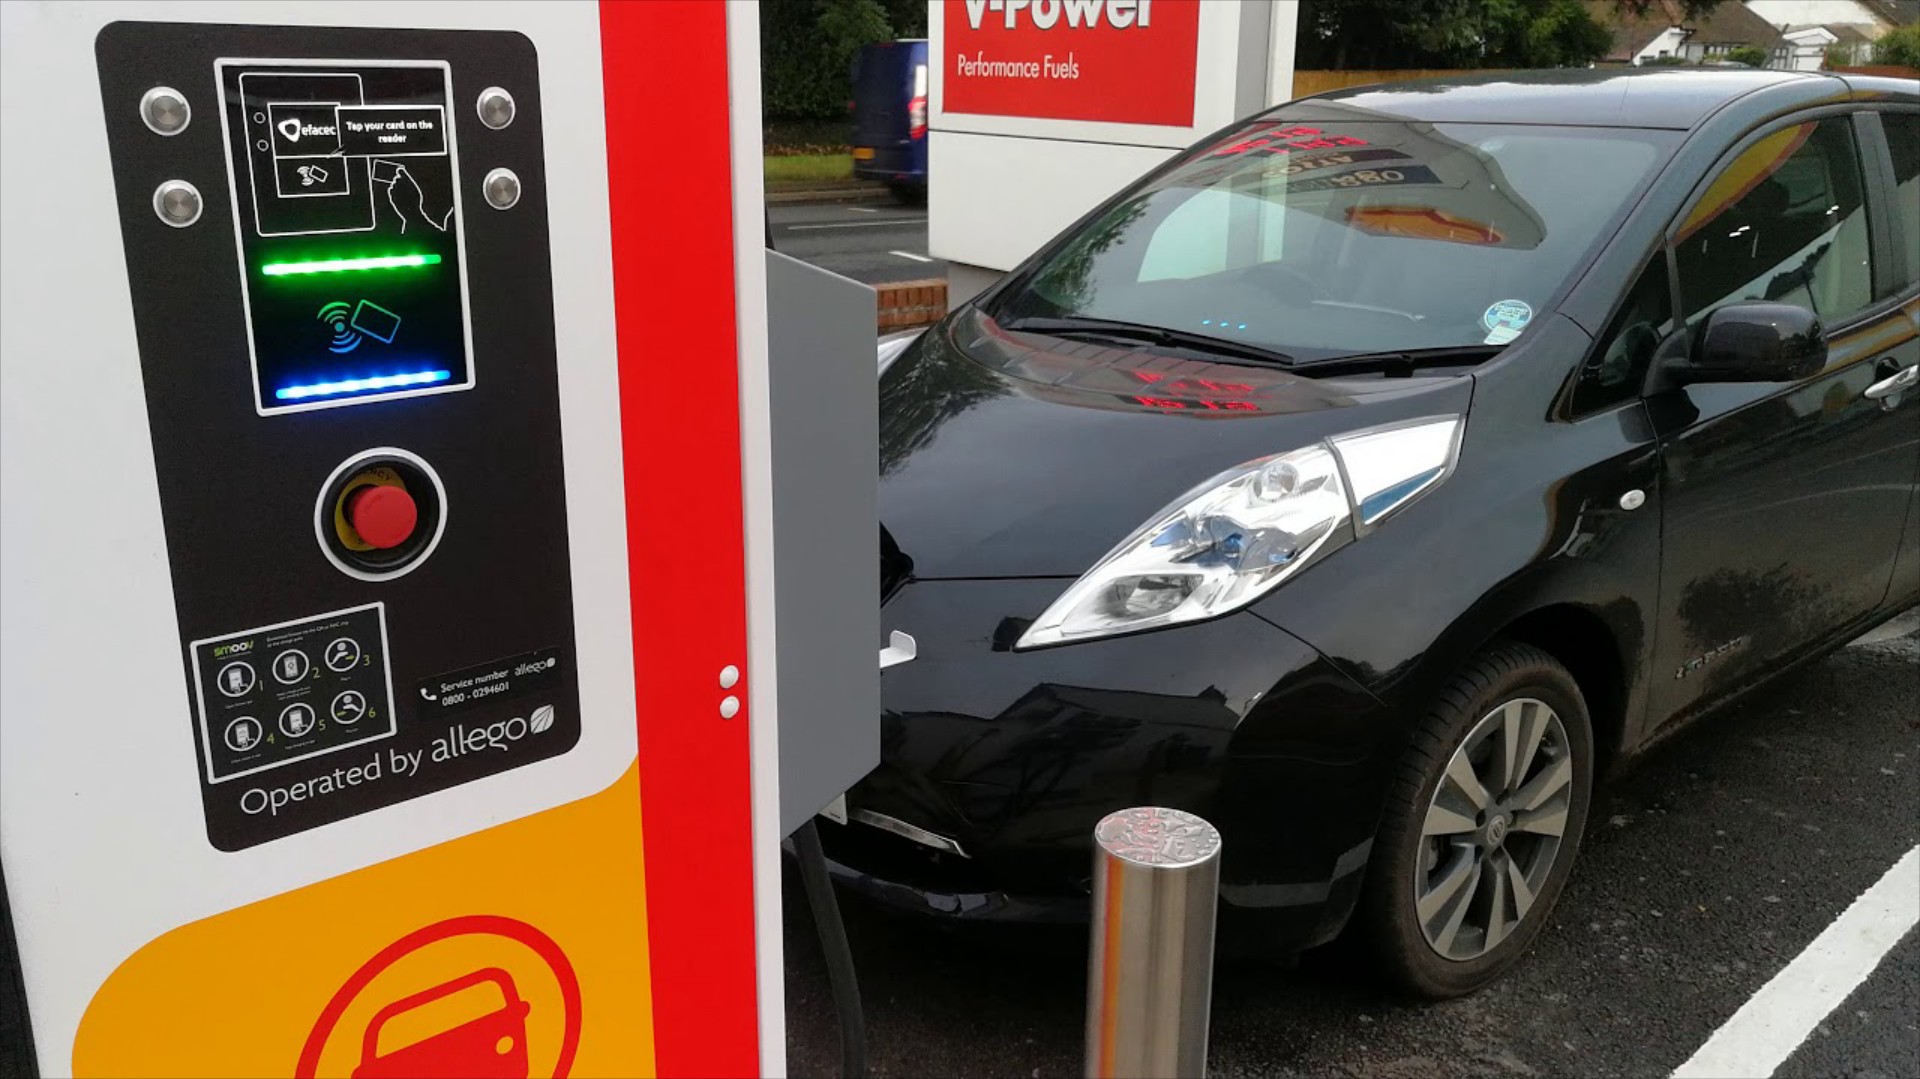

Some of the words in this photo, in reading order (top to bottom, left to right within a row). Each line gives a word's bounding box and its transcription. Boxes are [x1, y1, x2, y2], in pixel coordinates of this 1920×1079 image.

[964, 0, 1150, 29] V-Power
[957, 51, 1040, 79] Performance
[1043, 52, 1080, 79] Fuels
[301, 124, 337, 136] efacec
[346, 121, 361, 132] Tap
[364, 123, 384, 133] your
[386, 120, 405, 130] card
[406, 122, 417, 130] on
[419, 120, 433, 130] the
[378, 133, 407, 143] reader
[363, 654, 371, 666] 3
[312, 667, 321, 679] 2
[514, 660, 547, 677] allego
[441, 679, 473, 693] Service
[475, 669, 509, 684] number
[442, 693, 465, 706] 0800
[472, 681, 510, 699] 0294601
[368, 706, 376, 718] 6
[318, 719, 326, 731] 5
[266, 732, 275, 744] 4
[240, 752, 382, 816] Operated
[390, 748, 423, 777] by
[431, 716, 527, 763] allego
